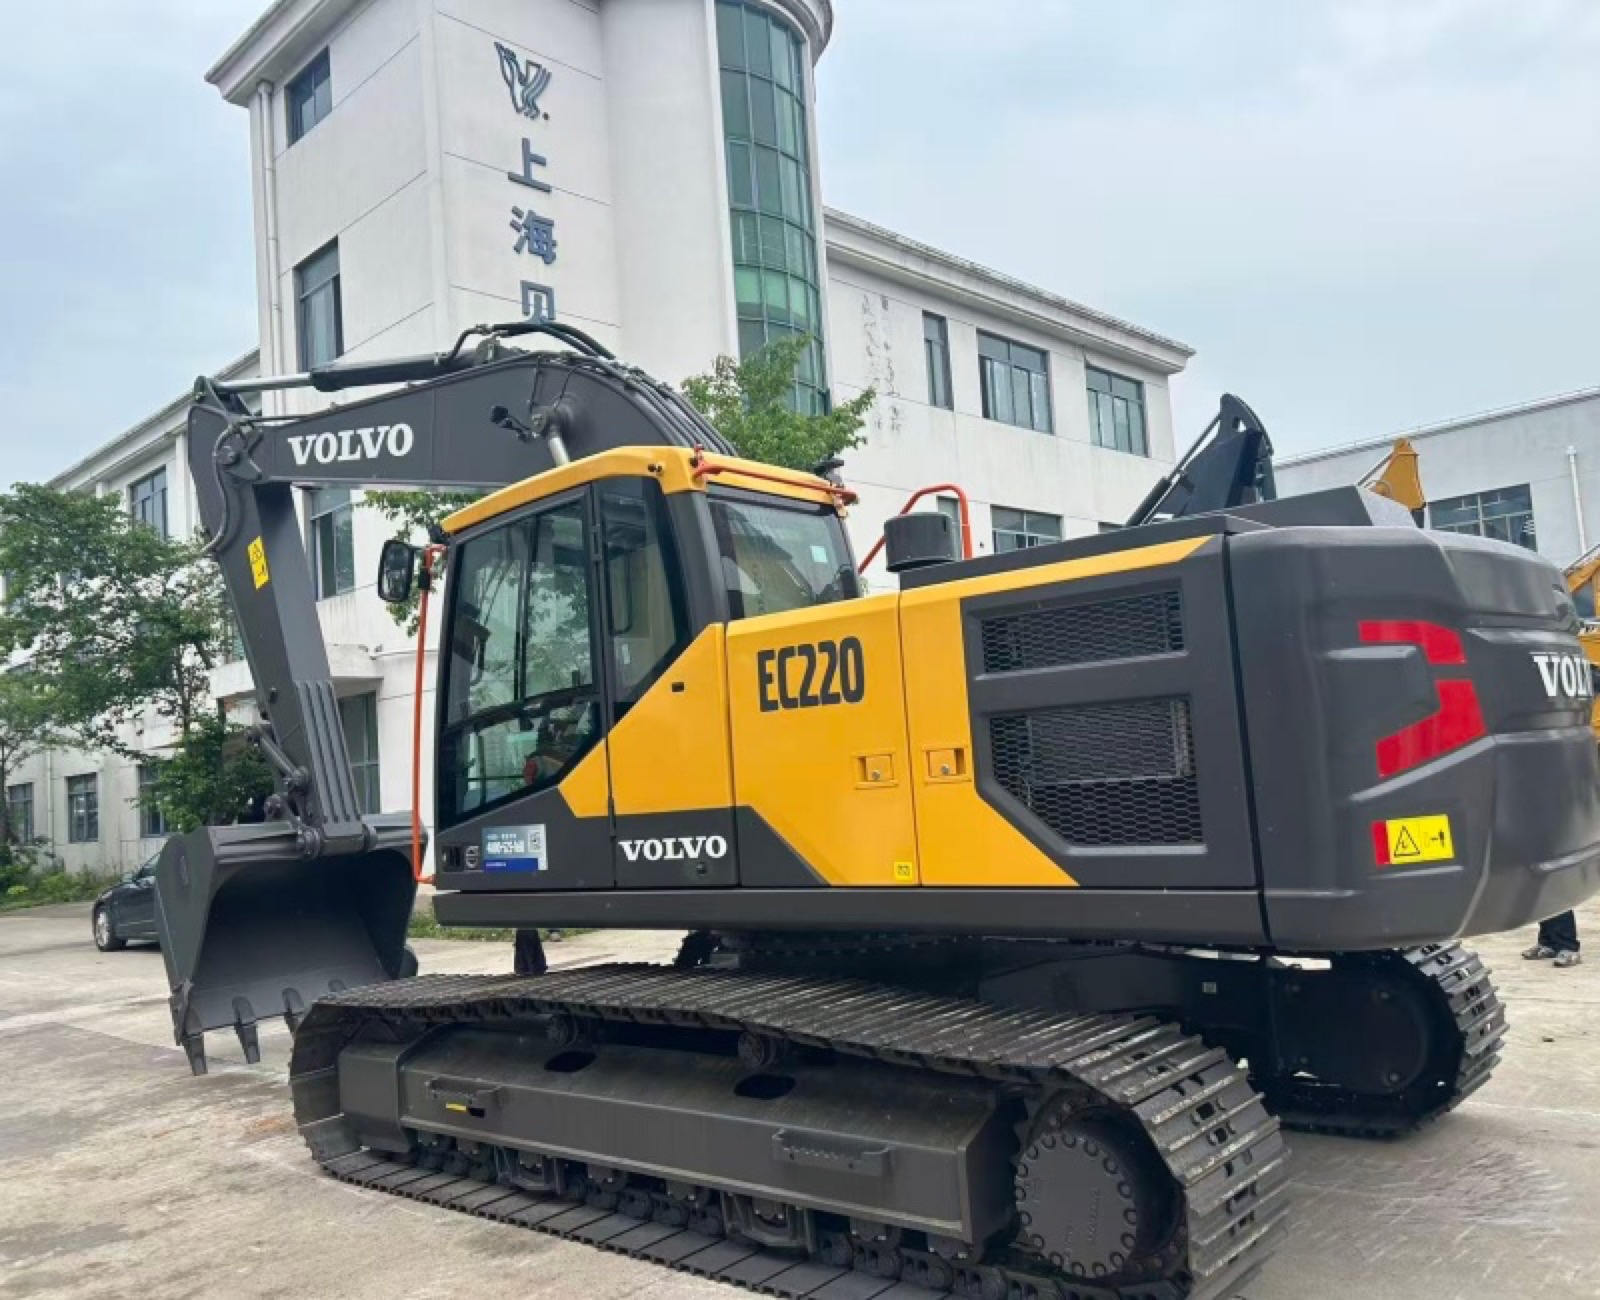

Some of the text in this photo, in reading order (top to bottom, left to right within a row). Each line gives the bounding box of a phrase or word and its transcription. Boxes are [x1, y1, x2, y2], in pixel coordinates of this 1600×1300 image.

[287, 423, 414, 466] VOLVO
[757, 636, 865, 712] EC220
[618, 835, 728, 861] VOLVO
